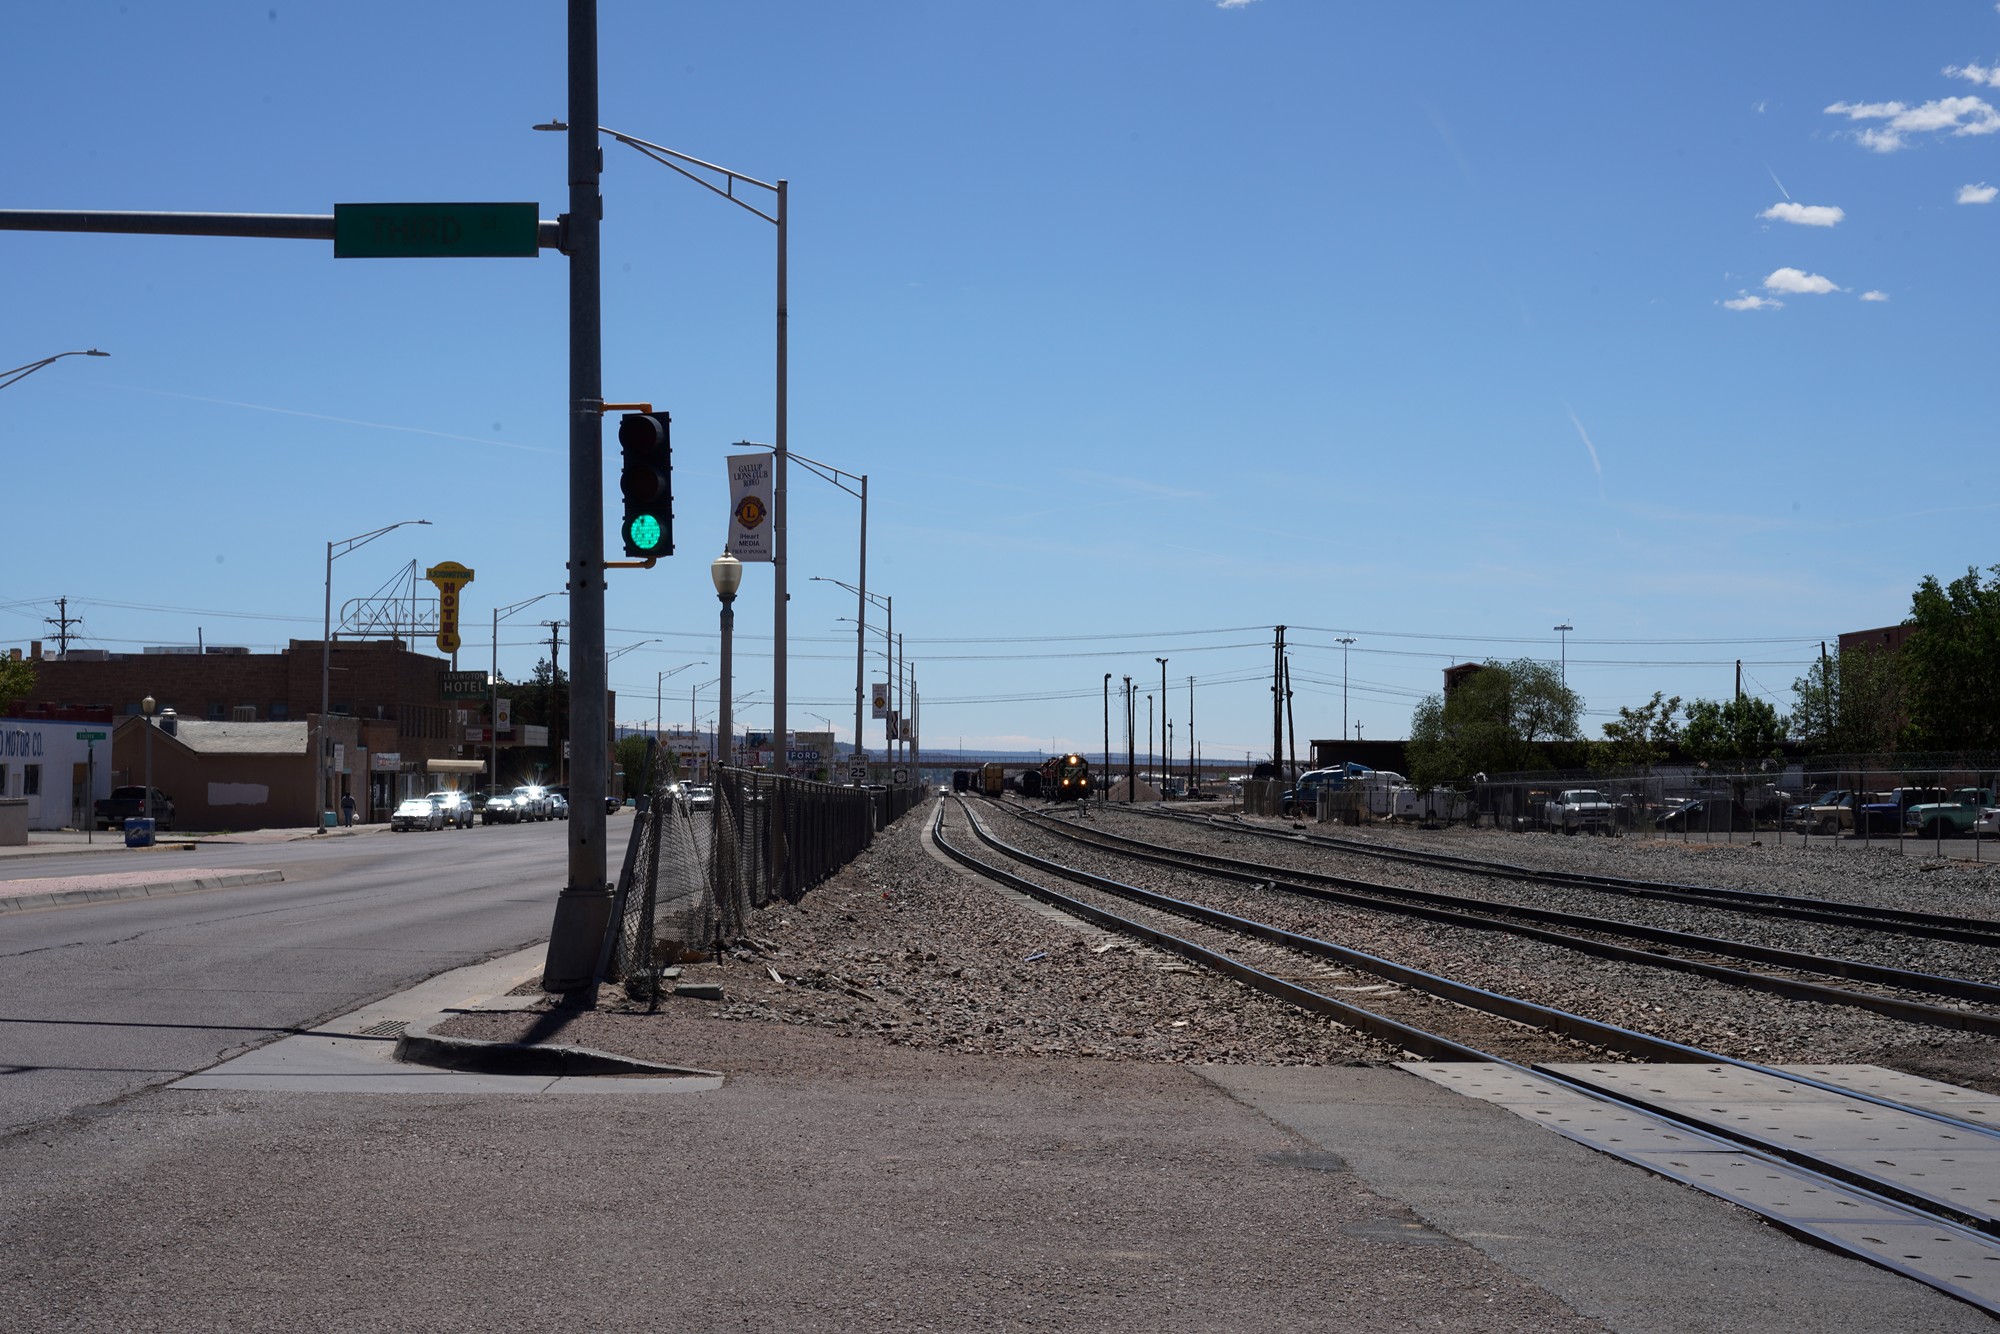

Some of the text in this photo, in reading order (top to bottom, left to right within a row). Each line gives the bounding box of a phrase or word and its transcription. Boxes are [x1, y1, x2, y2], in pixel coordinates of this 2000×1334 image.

[370, 215, 463, 245] THIRD
[739, 464, 762, 472] GALLUP
[733, 471, 769, 481] LIONS CLUB
[743, 479, 760, 487] RODEO
[443, 582, 455, 646] HOTEL
[443, 681, 486, 693] HOTEL
[5, 730, 30, 757] MOTOR
[32, 731, 44, 757] CO.
[791, 751, 818, 759] FORD
[850, 767, 866, 777] 25
